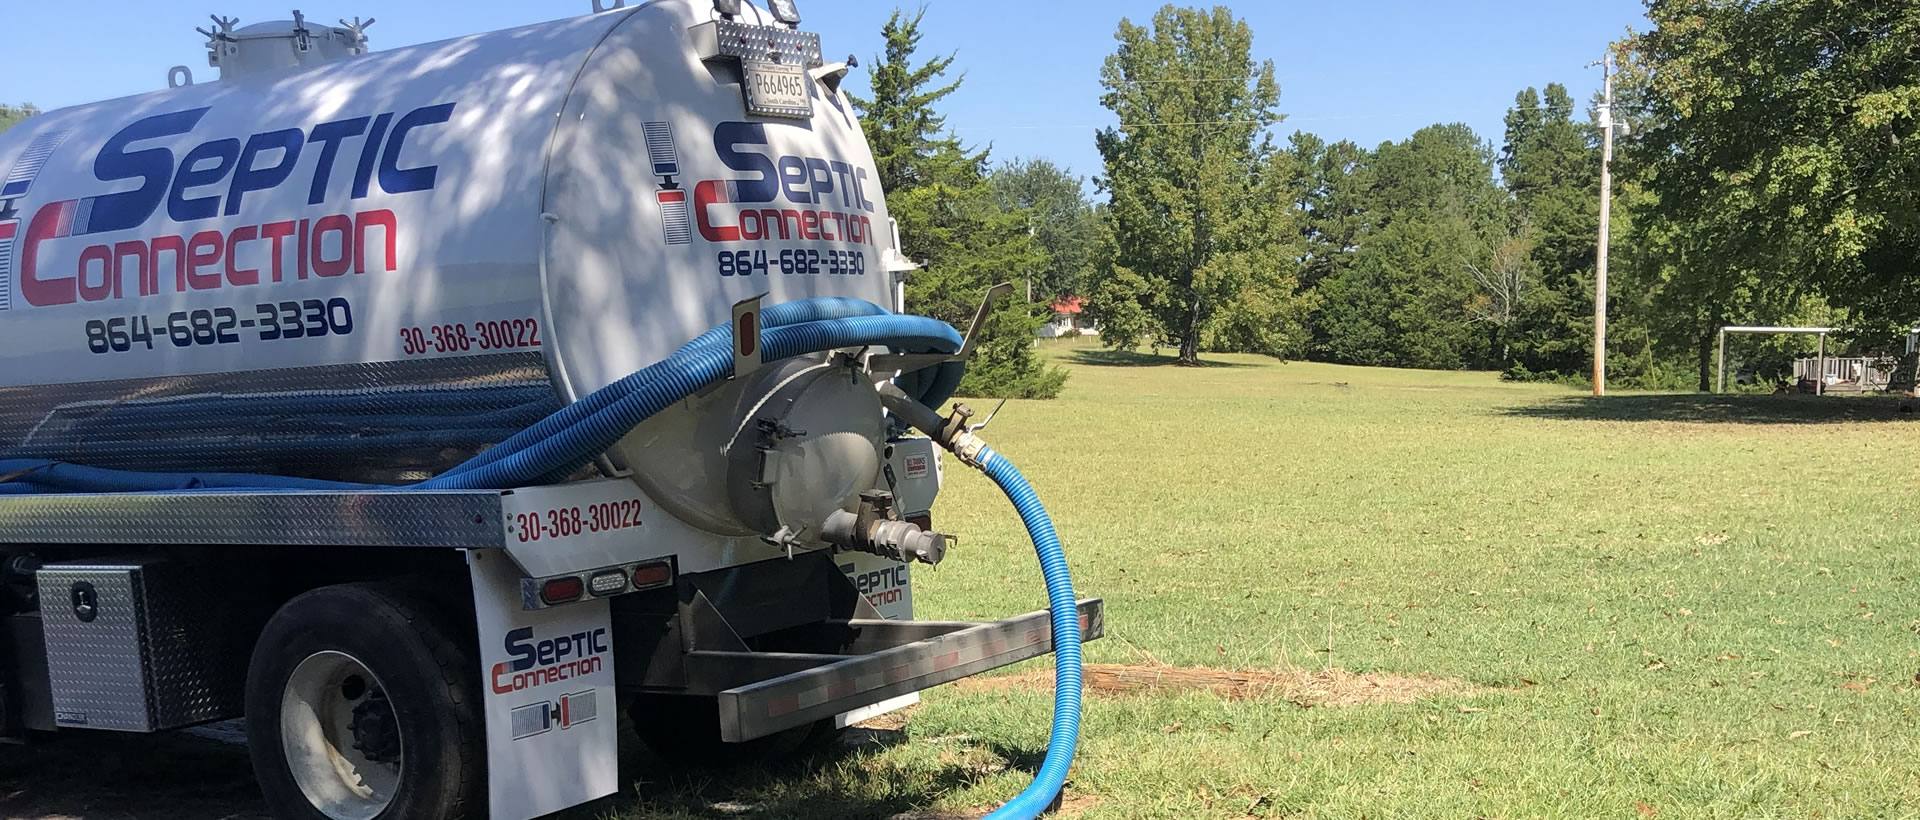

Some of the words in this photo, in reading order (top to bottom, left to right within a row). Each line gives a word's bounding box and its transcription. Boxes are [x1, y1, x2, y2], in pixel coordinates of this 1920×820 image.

[755, 73, 803, 97] P664965
[717, 249, 865, 277] 864-682-3330
[85, 297, 353, 354] 864-682-3330
[399, 318, 542, 355] 30-368-30022
[517, 499, 642, 543] 30-368-30022
